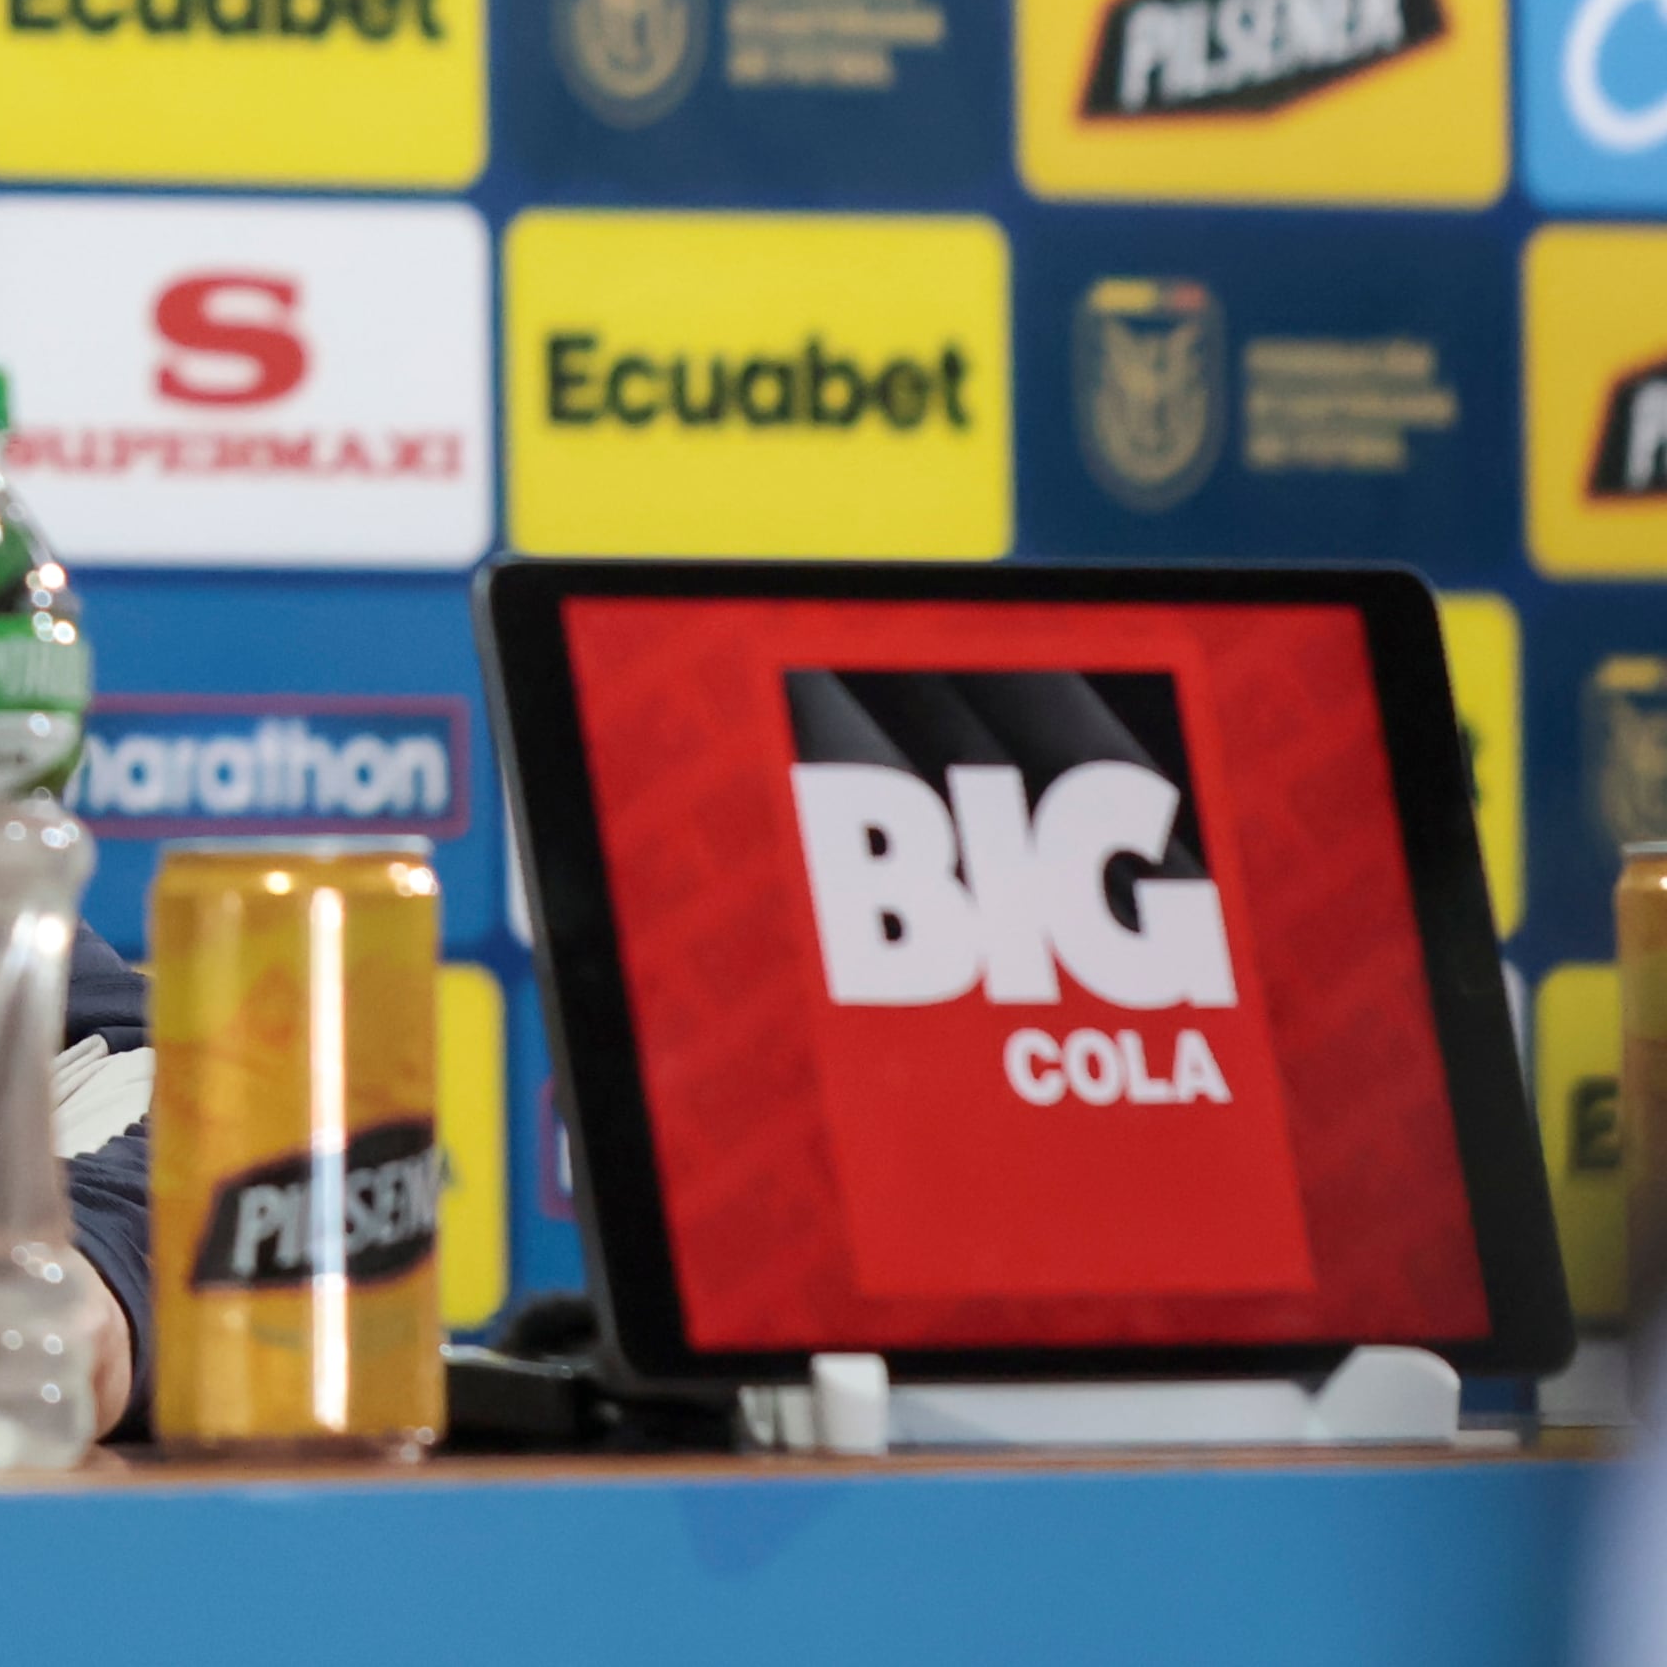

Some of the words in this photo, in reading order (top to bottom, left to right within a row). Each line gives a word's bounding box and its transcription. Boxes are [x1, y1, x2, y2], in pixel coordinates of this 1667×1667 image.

[152, 272, 310, 410] S
[543, 331, 970, 433] Ecuabet
[789, 759, 1239, 1011] BIG
[1003, 1027, 1232, 1107] COLA
